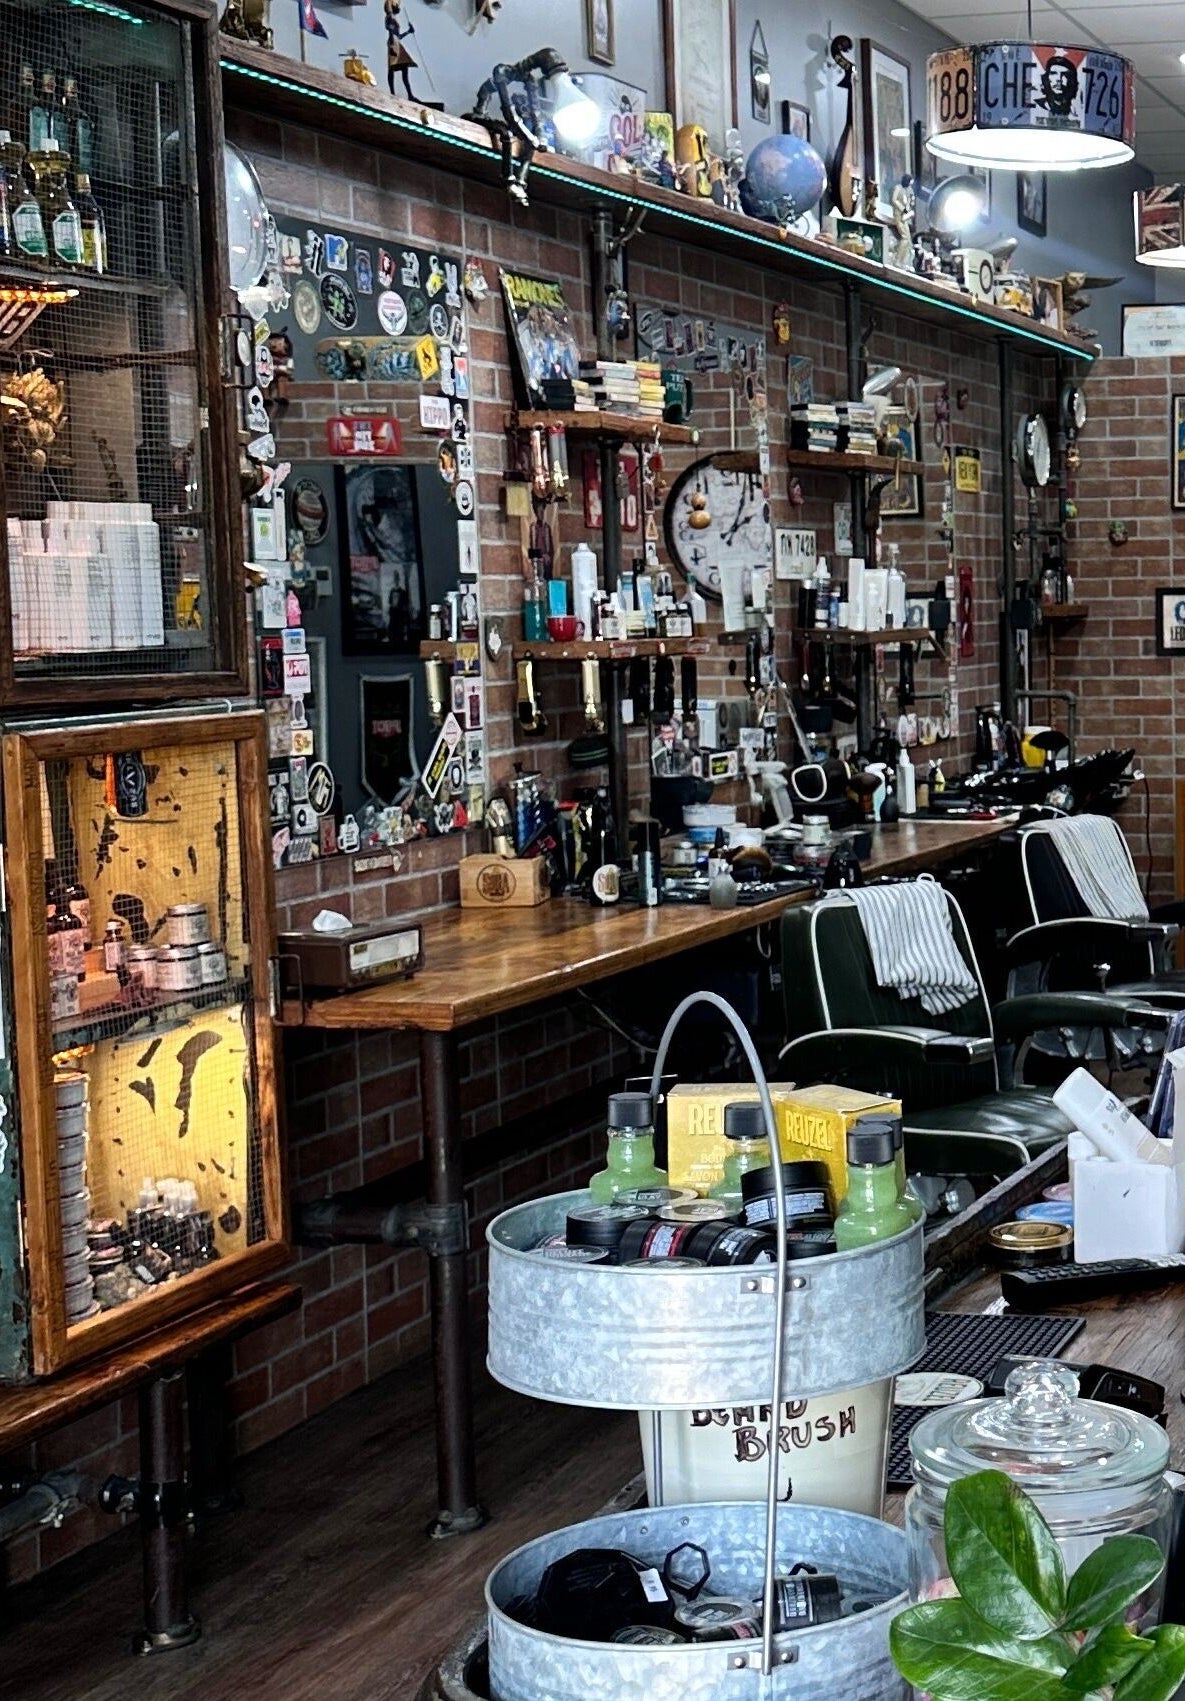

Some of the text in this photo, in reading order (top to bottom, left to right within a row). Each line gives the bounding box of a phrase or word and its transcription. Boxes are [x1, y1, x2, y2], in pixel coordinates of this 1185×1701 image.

[984, 61, 1120, 120] CHE 726
[1170, 626, 1185, 641] LED
[786, 1110, 834, 1152] REUZEL
[732, 1405, 856, 1462] BRUSH
